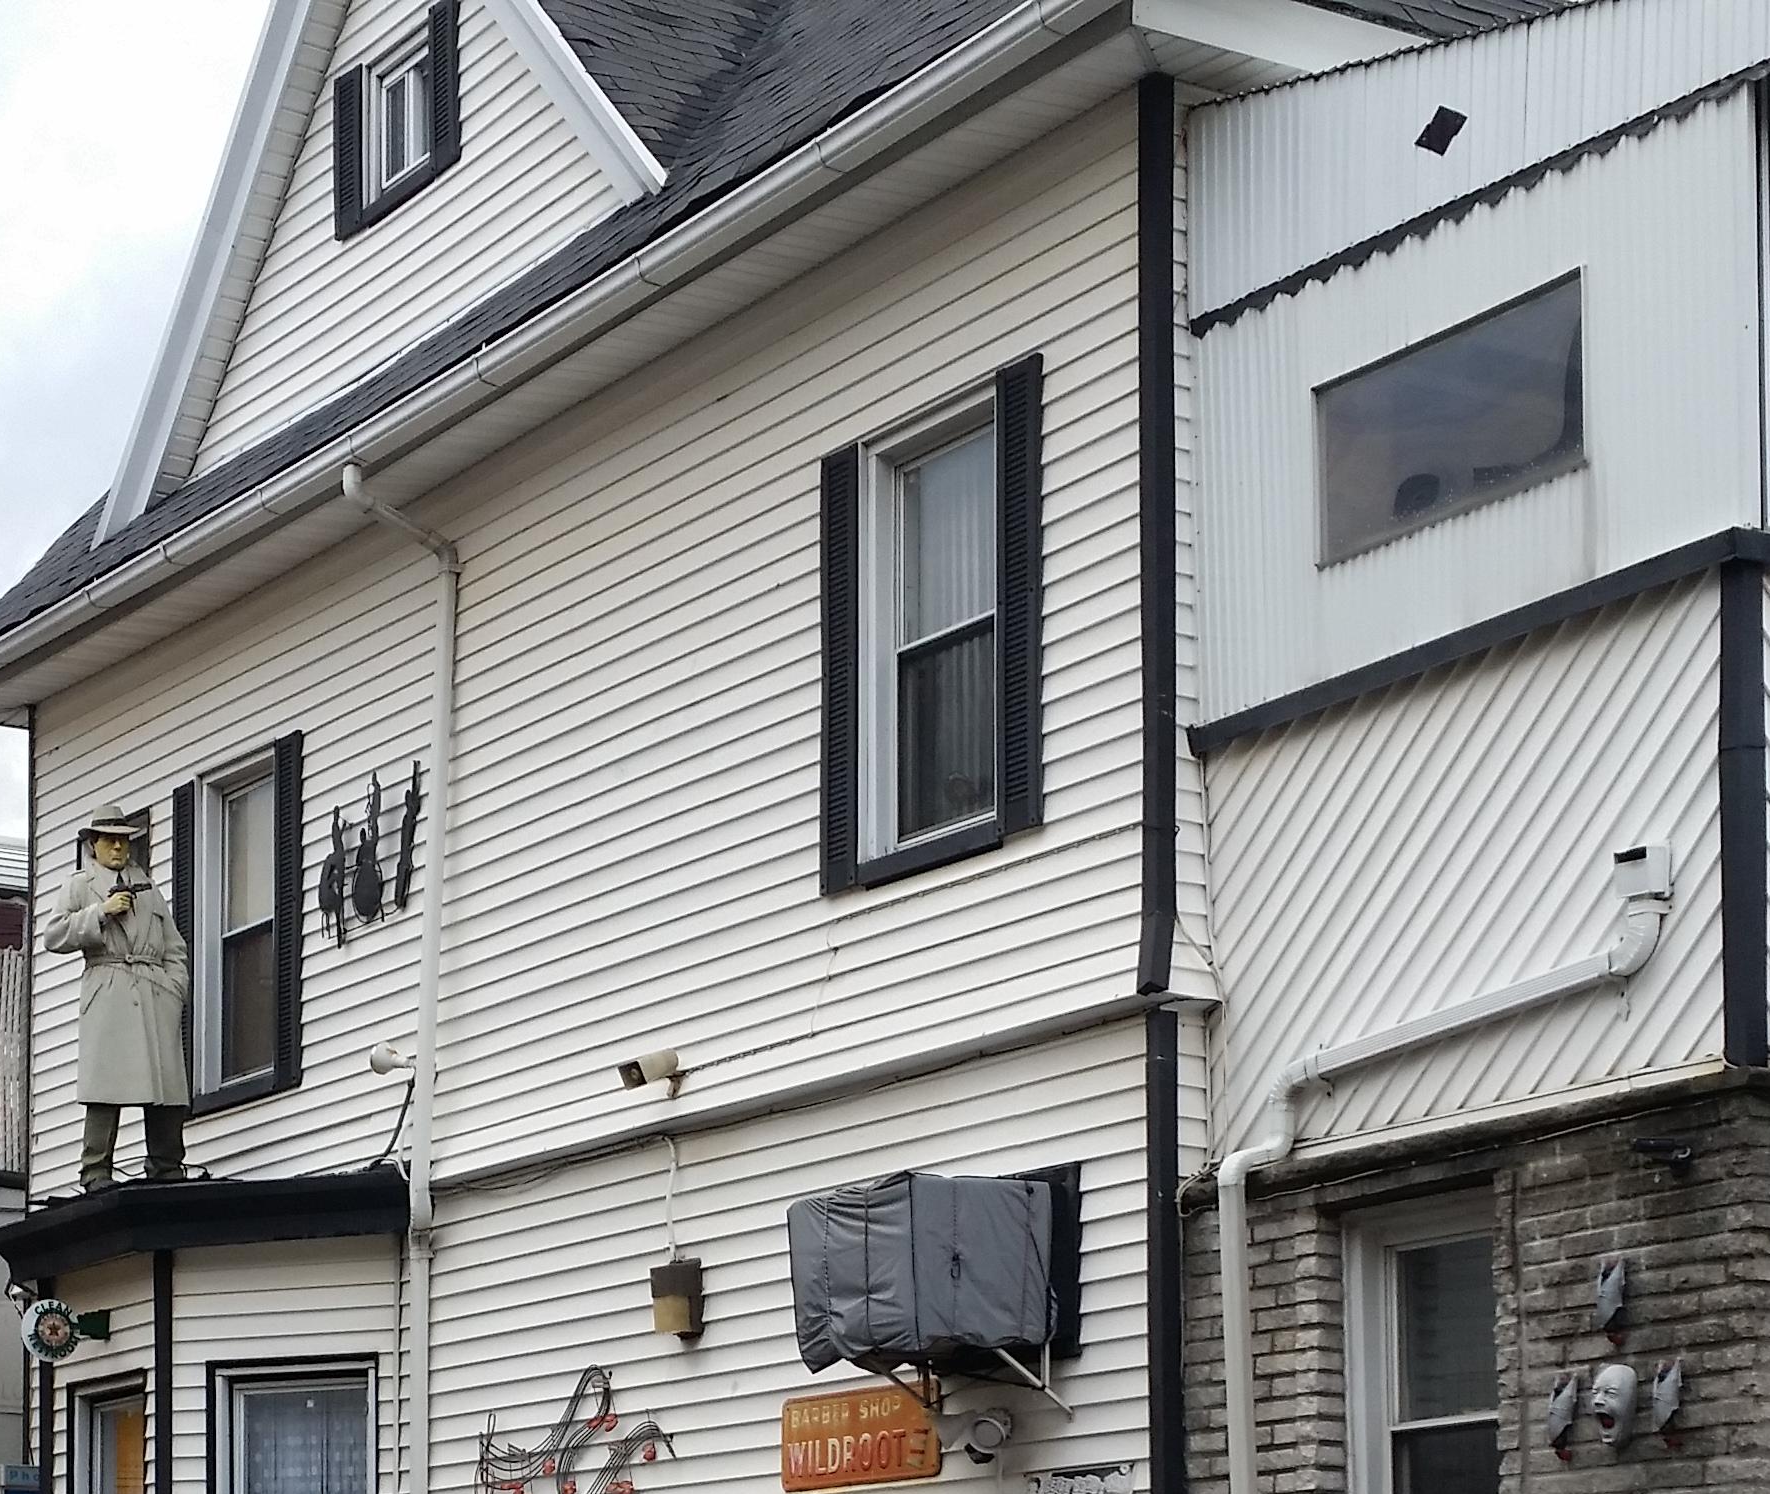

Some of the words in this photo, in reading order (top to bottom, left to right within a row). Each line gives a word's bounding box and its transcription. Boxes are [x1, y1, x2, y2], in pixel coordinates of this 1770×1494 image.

[34, 1301, 72, 1315] CLEAN
[791, 1403, 850, 1428] BARBER
[859, 1395, 901, 1419] SHOP
[788, 1429, 906, 1478] WILDROOT
